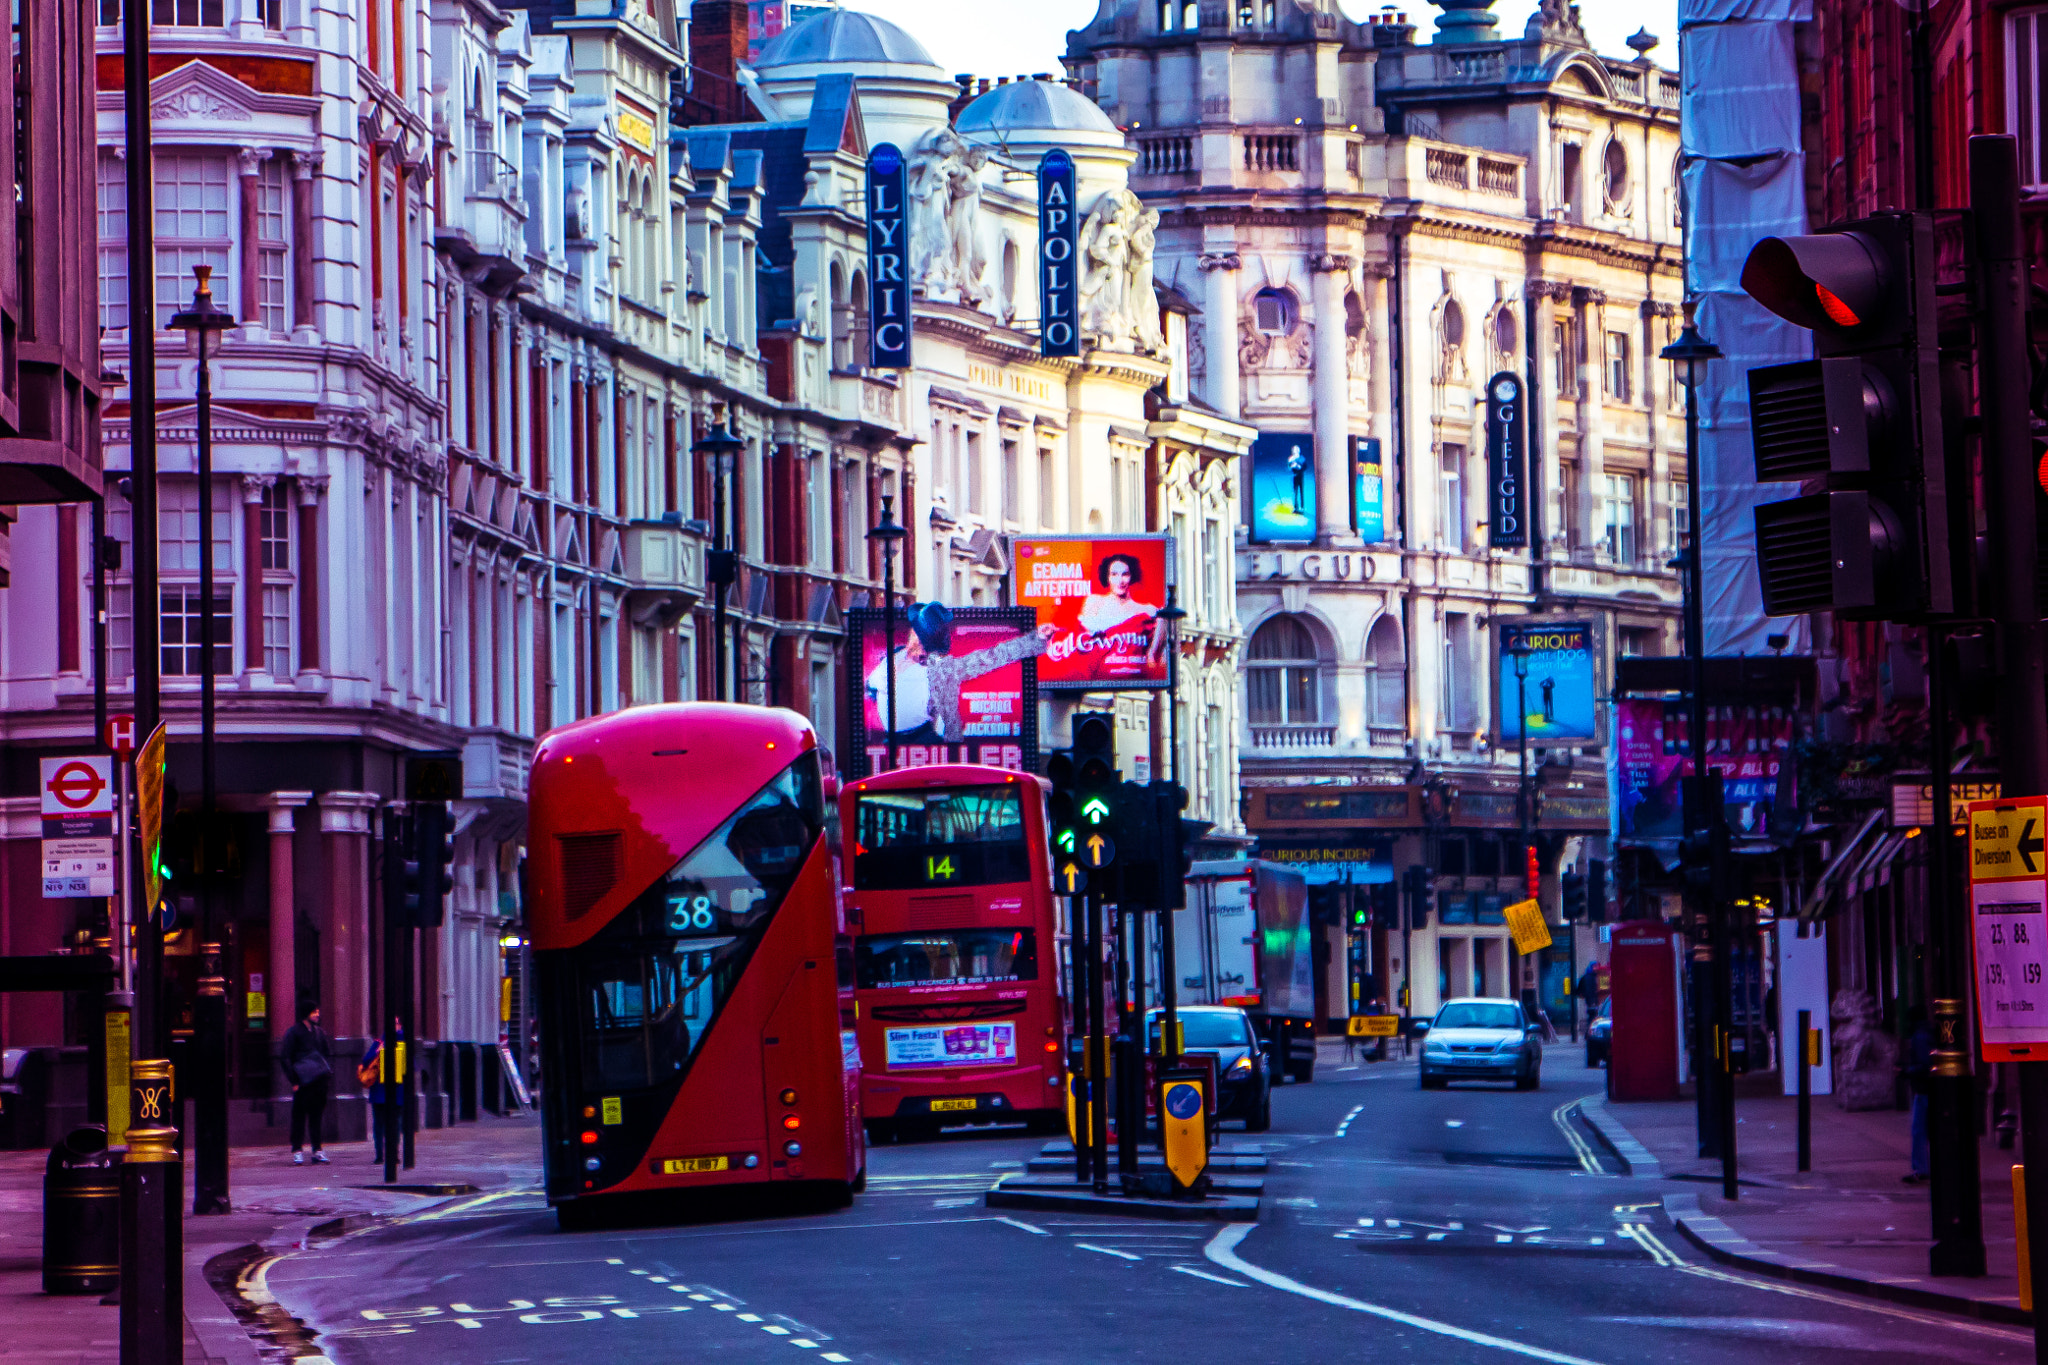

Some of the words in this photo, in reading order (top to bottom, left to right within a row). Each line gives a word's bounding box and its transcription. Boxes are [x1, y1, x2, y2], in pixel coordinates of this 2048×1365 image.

[873, 184, 904, 352] LYRIC
[1045, 181, 1073, 347] APOLLO
[1497, 404, 1517, 534] GIELGUD
[1033, 562, 1083, 579] GEMMA
[1248, 554, 1377, 580] ELGUD
[1024, 580, 1091, 597] ARTERTON
[970, 700, 1012, 713] MICHAEL
[112, 722, 135, 748] H
[963, 723, 1011, 736] JACKSON
[1975, 823, 1997, 840] Buses
[1998, 825, 2009, 839] on
[1262, 848, 1320, 861] CURIOUS
[1323, 848, 1376, 860] INCIDENT
[1975, 848, 2012, 865] Diversion
[49, 865, 59, 873] 14
[96, 863, 107, 871] 38
[927, 856, 955, 880] 14
[45, 884, 63, 892] N19
[69, 883, 86, 891] N38
[668, 895, 714, 931] 38
[2023, 962, 2042, 984] 159
[890, 1031, 910, 1041] Slim
